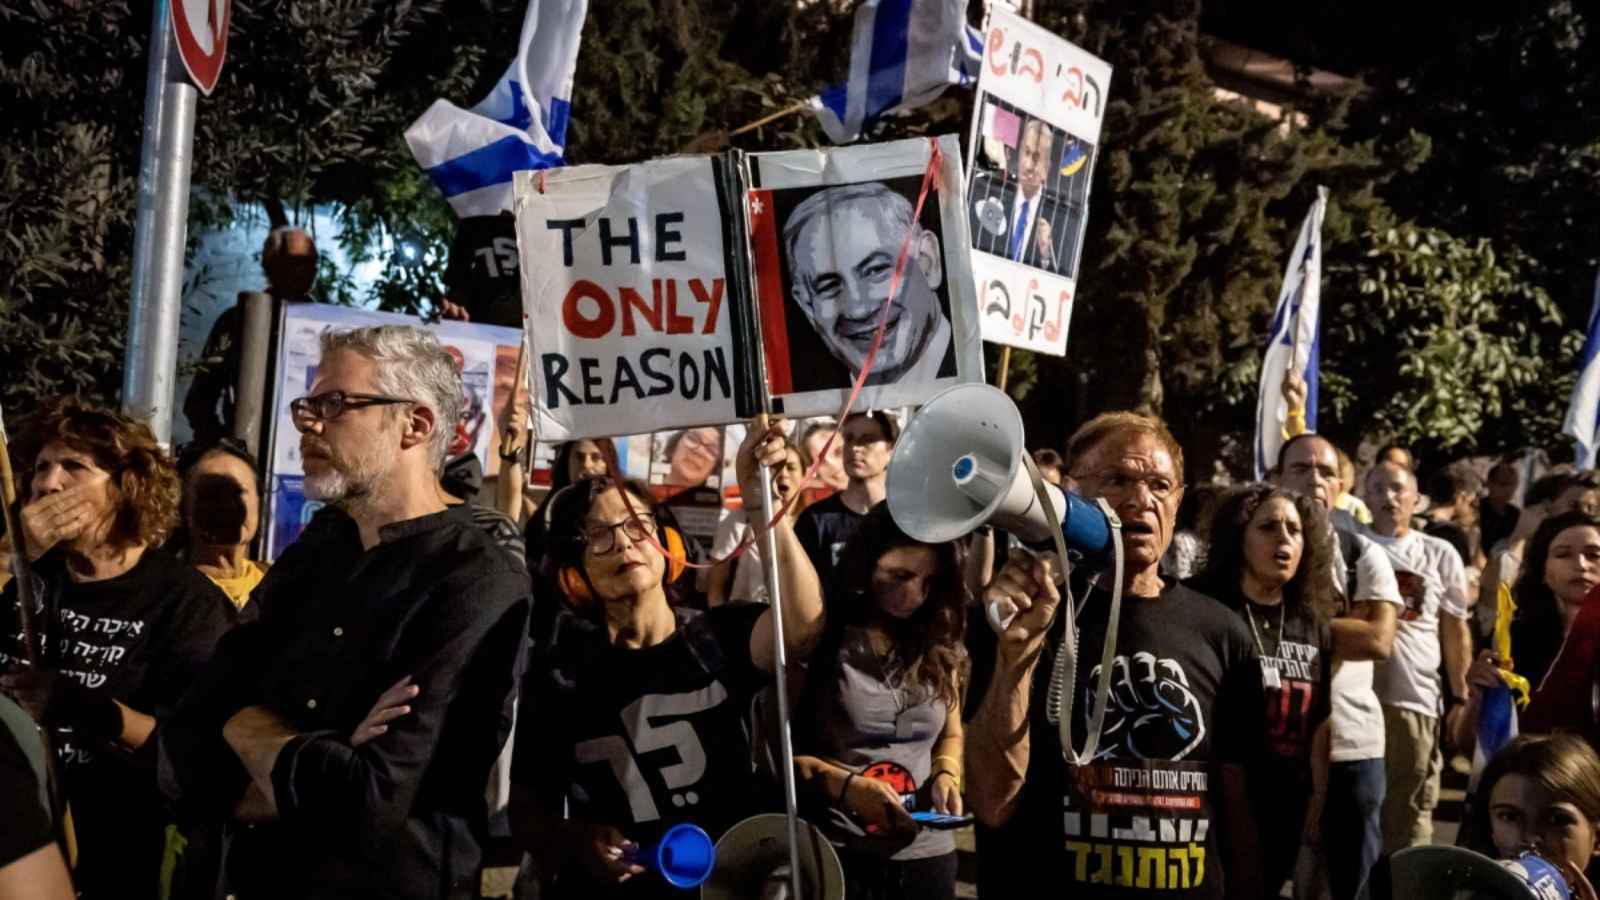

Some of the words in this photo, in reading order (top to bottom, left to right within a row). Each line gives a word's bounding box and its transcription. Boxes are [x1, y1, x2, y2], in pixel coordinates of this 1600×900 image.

[546, 212, 687, 267] THE
[562, 277, 725, 339] ONLY
[541, 347, 732, 409] REASON
[1064, 841, 1207, 890] להתנגד
